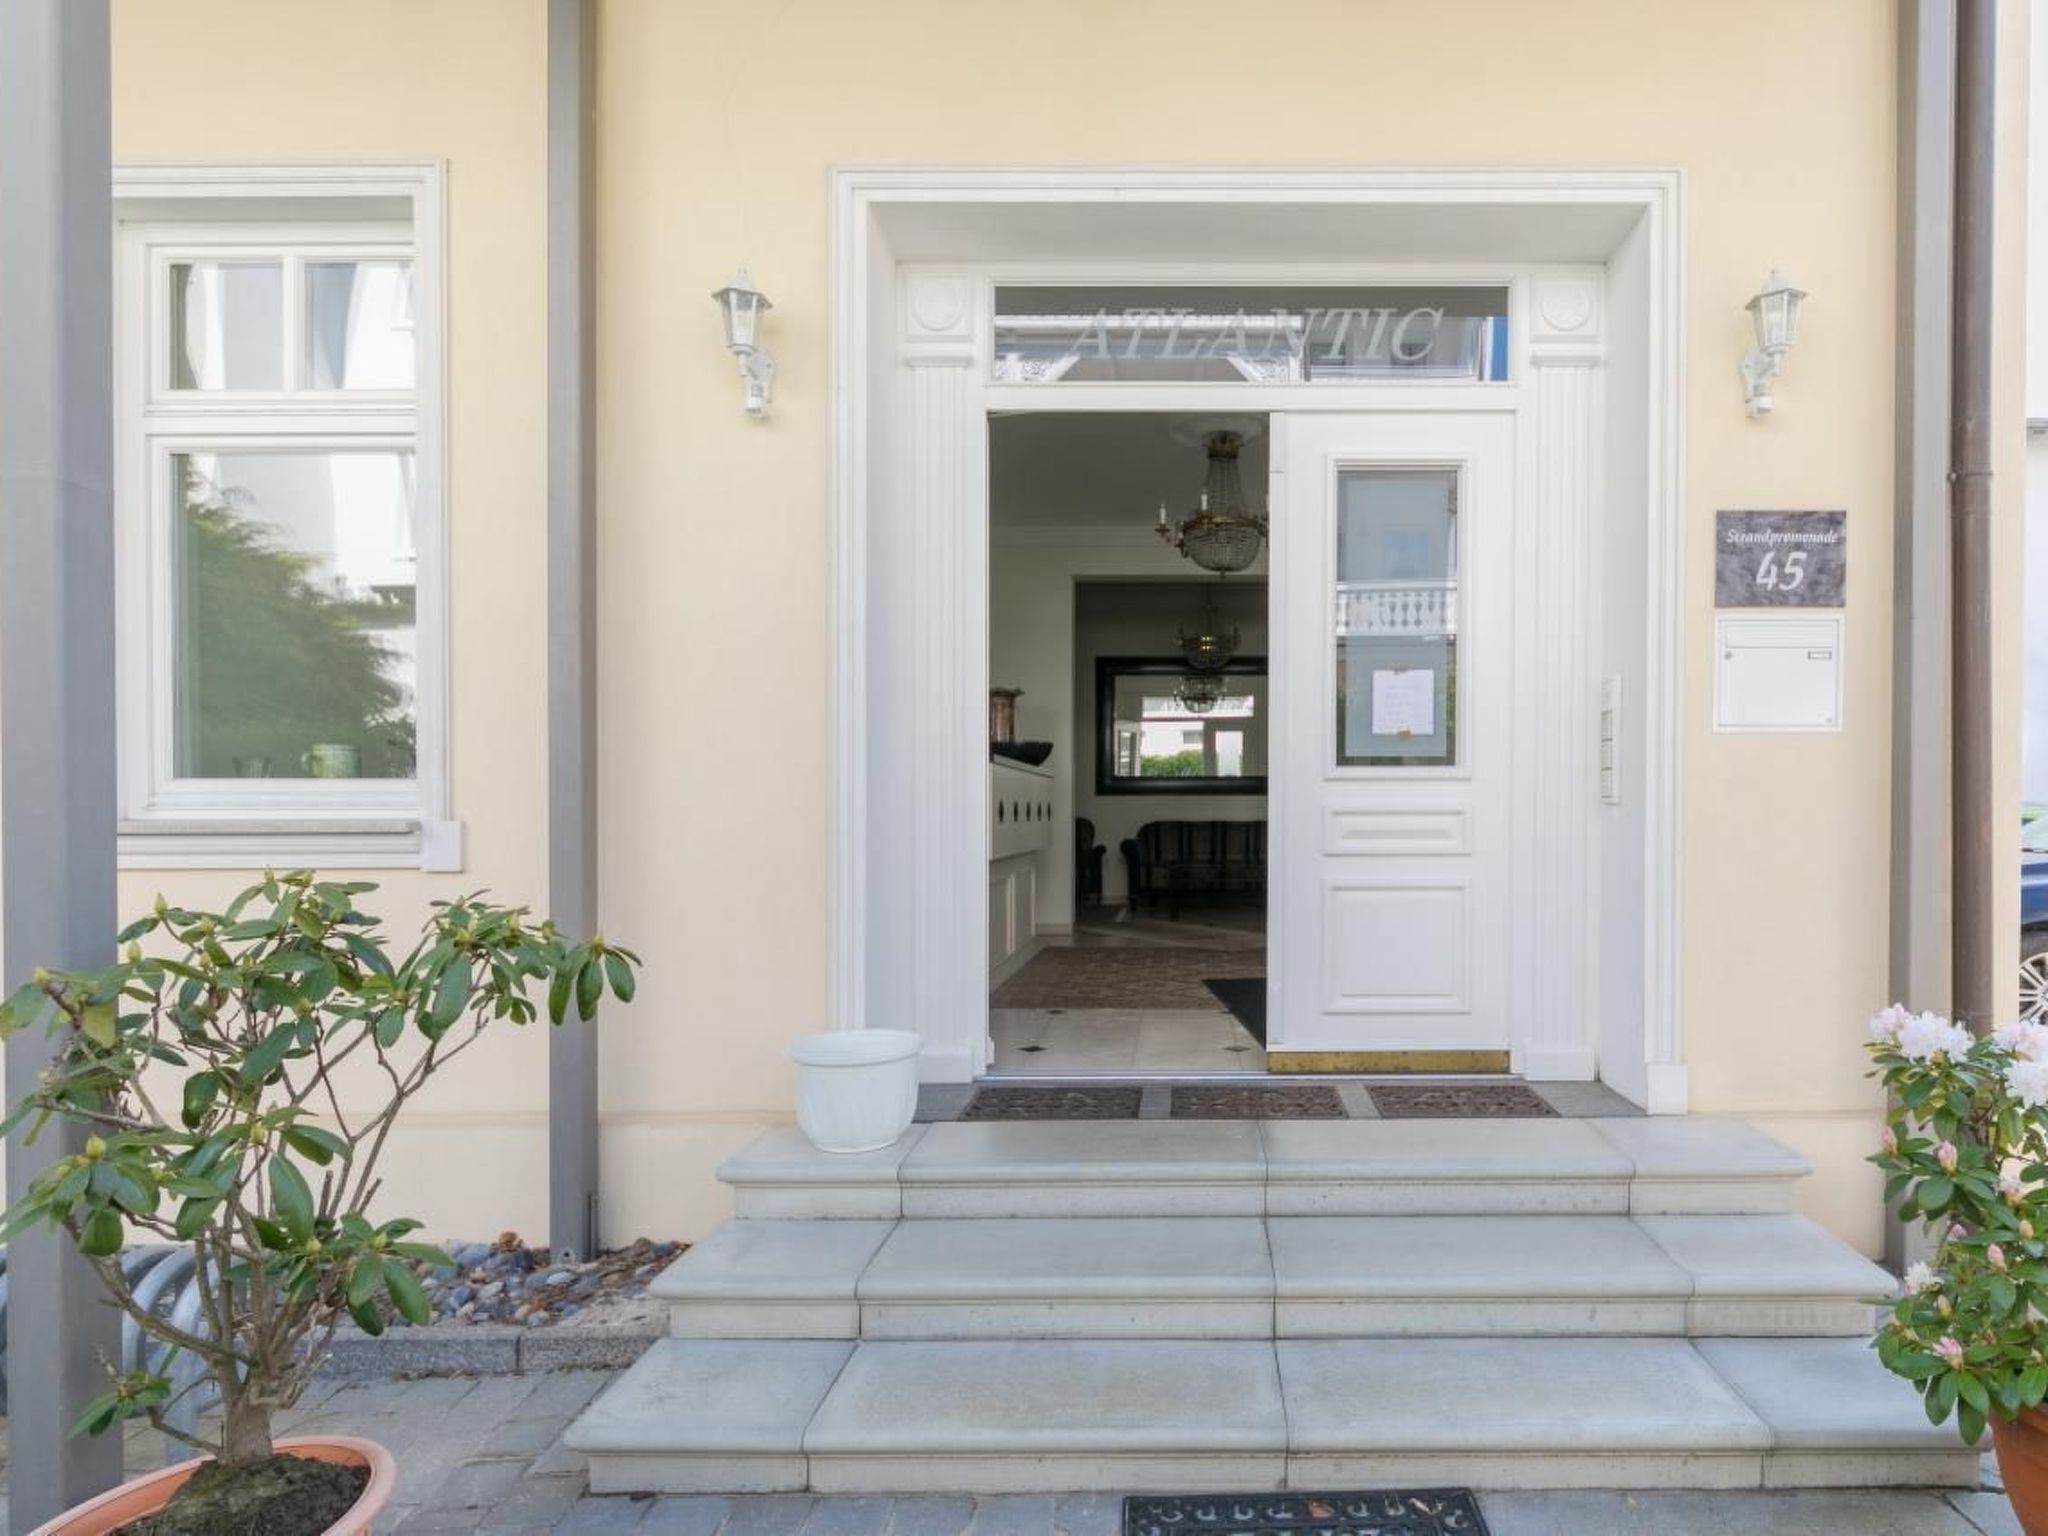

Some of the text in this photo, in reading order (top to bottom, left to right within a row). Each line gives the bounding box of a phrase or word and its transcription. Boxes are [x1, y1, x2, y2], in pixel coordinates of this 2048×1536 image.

[1067, 306, 1444, 361] ATLANTIC
[1726, 528, 1839, 547] Strandpromenade
[1755, 551, 1808, 591] 45
